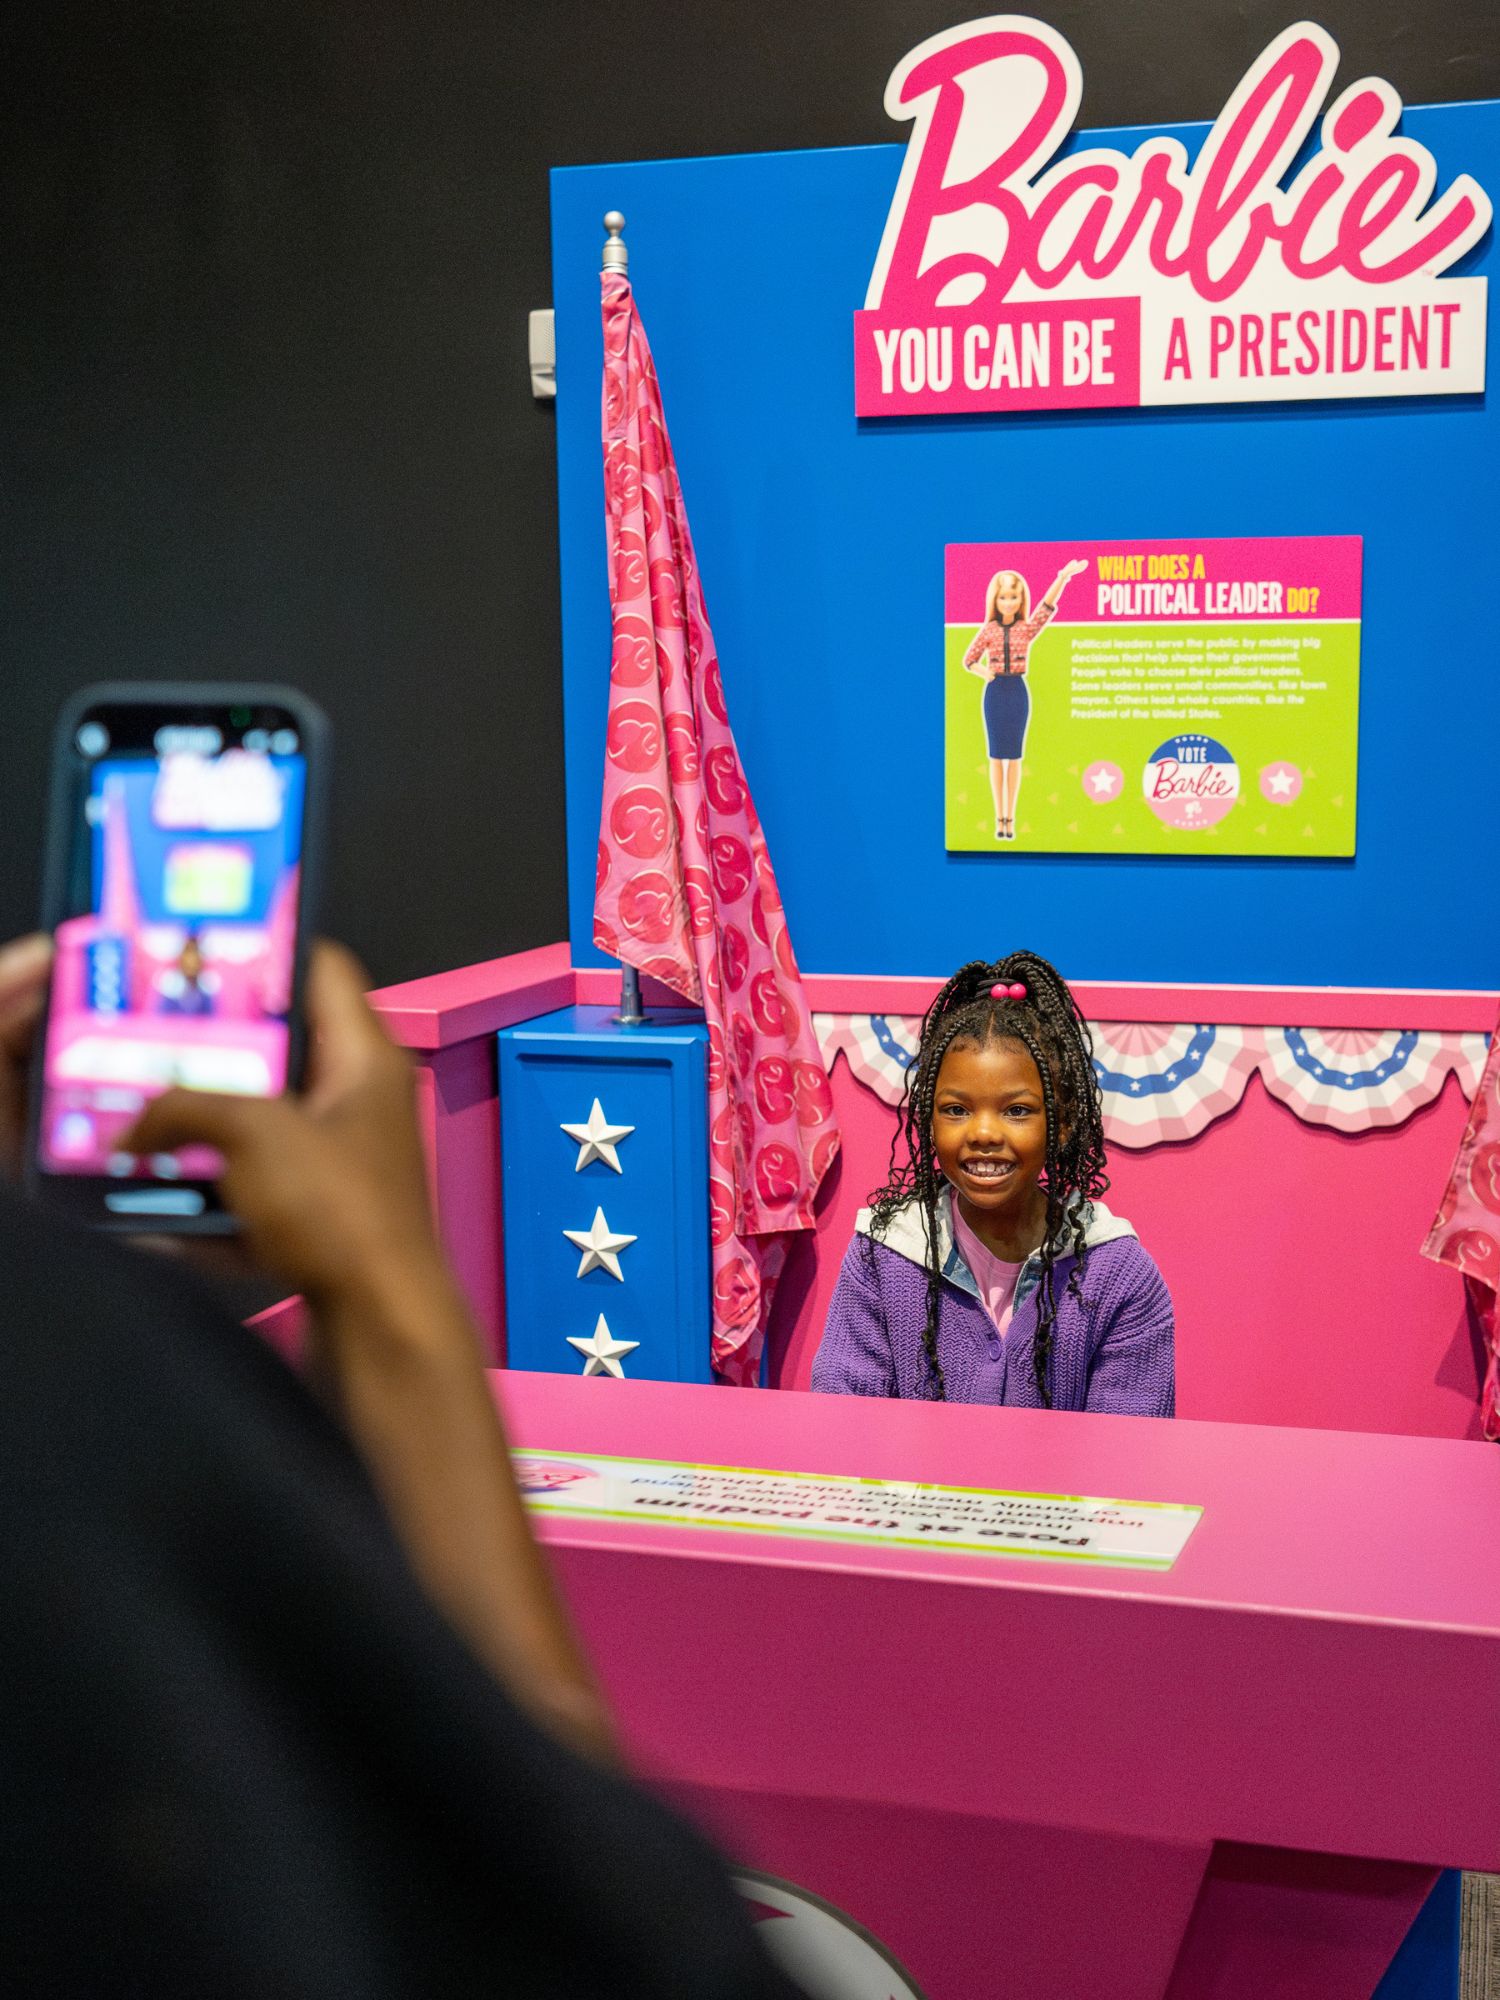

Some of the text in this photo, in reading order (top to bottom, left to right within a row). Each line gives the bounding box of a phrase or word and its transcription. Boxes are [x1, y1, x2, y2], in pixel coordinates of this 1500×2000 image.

[880, 31, 1476, 307] Barbie
[873, 303, 1461, 394] YOU CAN BE A PRESIDENT
[1097, 554, 1205, 580] WHAT DOES A
[1097, 581, 1320, 616] POLITICAL LEADER DO?
[1072, 638, 1321, 650] Political leaders serve the public by making big
[1072, 653, 1120, 662] decisions
[1122, 653, 1142, 662] that
[1144, 653, 1169, 664] help
[1171, 653, 1203, 664] shape
[1206, 652, 1230, 662] their
[1072, 667, 1107, 678] People
[1109, 667, 1132, 677] vote
[1148, 667, 1186, 677] choose
[1188, 667, 1212, 676] their
[1215, 667, 1258, 678] political
[1072, 682, 1100, 691] Some
[1102, 681, 1141, 691] leaders
[1175, 681, 1203, 690] small
[1278, 681, 1298, 690] like
[1300, 681, 1327, 690] town
[1114, 695, 1149, 705] Others
[1151, 695, 1175, 704] lead
[1178, 695, 1209, 704] whole
[1265, 694, 1285, 704] like
[1287, 694, 1305, 704] the
[1072, 709, 1118, 719] President
[1119, 709, 1131, 719] of
[1132, 709, 1150, 719] the
[1152, 709, 1187, 719] United
[1177, 747, 1207, 762] VOTE
[1153, 759, 1234, 799] Barbie
[630, 1478, 712, 1490] friend
[795, 1485, 853, 1495] take
[745, 1489, 811, 1499] have
[720, 1494, 825, 1508] making
[882, 1501, 985, 1513] speech
[991, 1501, 1078, 1514] family
[633, 1498, 1089, 1546] Pose at the podium
[952, 1516, 1072, 1531] Imagine
[995, 1511, 1143, 1527] important
